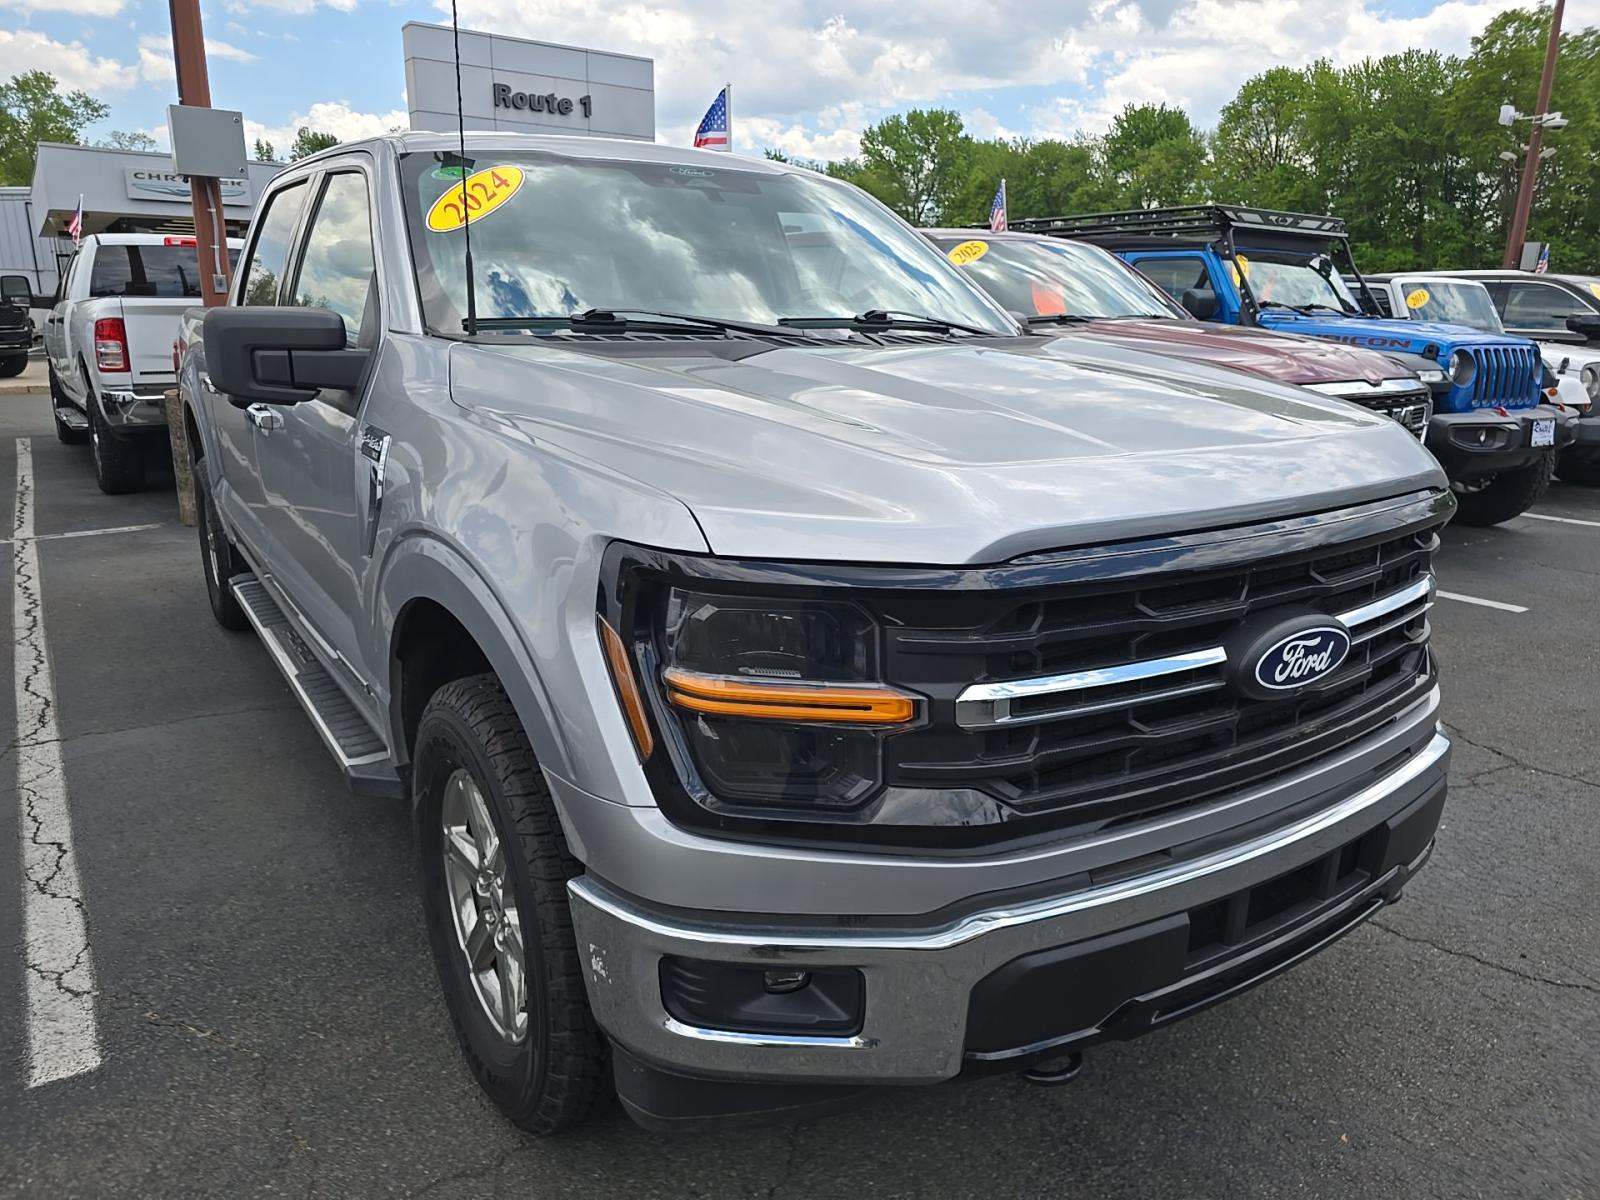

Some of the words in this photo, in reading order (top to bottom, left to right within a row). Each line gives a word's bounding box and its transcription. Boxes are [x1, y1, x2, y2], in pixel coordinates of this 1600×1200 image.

[493, 83, 574, 115] Route
[579, 95, 592, 118] 1
[133, 172, 243, 187] CHRER
[443, 170, 510, 224] 2024
[953, 242, 982, 264] 2025
[1274, 636, 1334, 683] Ford
